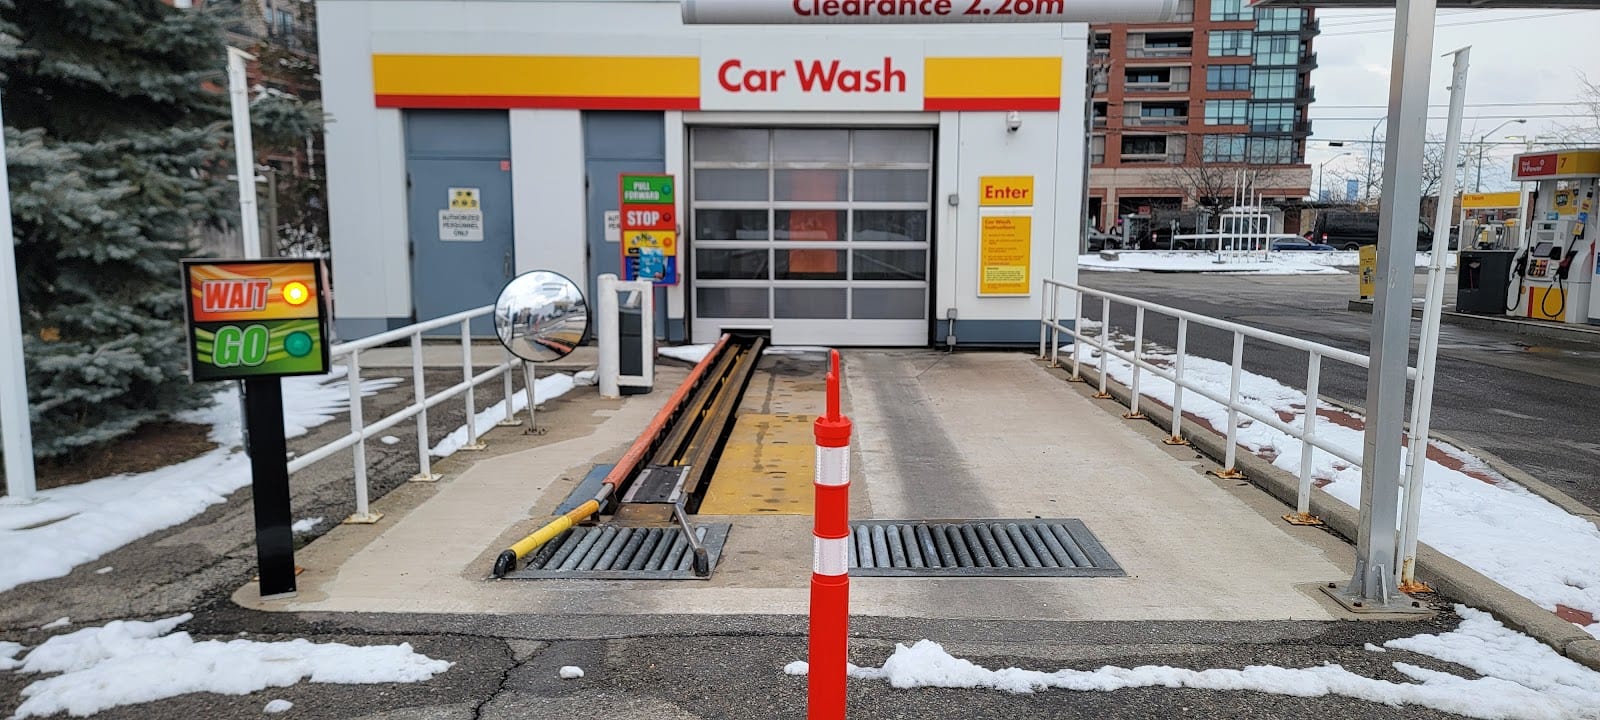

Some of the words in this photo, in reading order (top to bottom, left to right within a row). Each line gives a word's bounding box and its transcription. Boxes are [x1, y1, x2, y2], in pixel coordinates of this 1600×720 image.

[793, 0, 952, 16] Clearance
[718, 59, 786, 93] Car
[795, 57, 906, 93] Wash
[1561, 157, 1568, 168] 7
[633, 182, 650, 190] PULL
[985, 185, 1029, 199] Enter
[624, 191, 660, 200] FORWARD
[442, 214, 480, 223] AUTHORIZED
[627, 211, 660, 226] STOP
[203, 279, 271, 312] WAIT
[213, 325, 269, 367] GO
